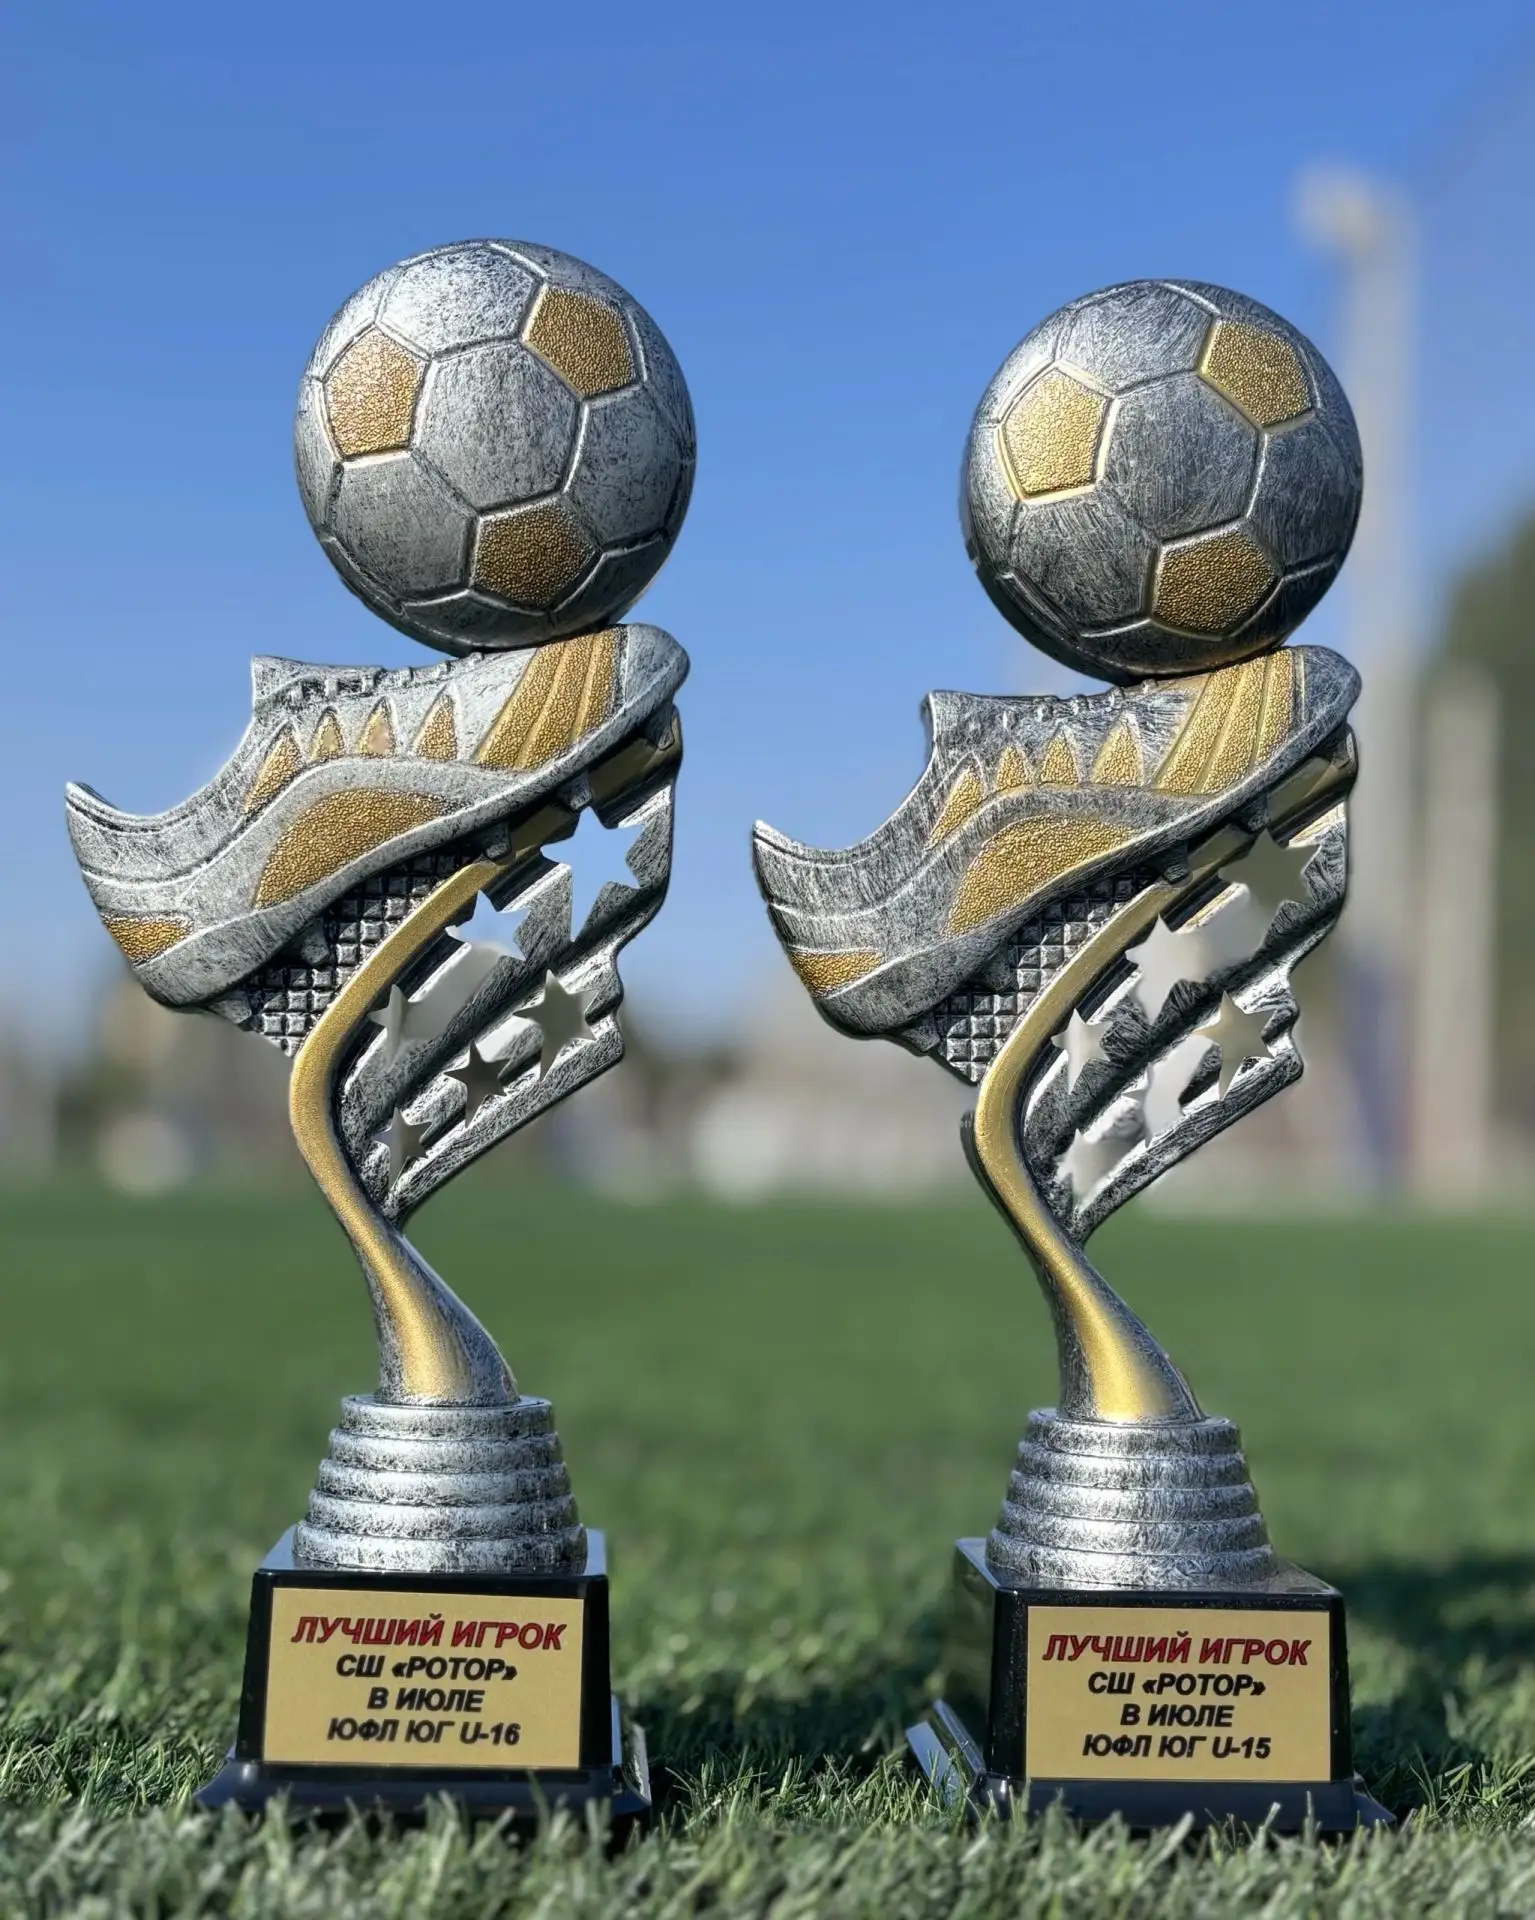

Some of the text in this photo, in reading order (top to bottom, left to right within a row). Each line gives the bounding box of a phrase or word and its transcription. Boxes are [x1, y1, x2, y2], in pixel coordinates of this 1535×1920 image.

[291, 1613, 565, 1649] ЛУЧШИЙ ИГРОК
[1042, 1630, 1312, 1665] ЛУЧШИЙ ИГРОК
[336, 1654, 516, 1680] СШ «РОТОР»
[1088, 1671, 1266, 1696] СШ «РОТОР»
[367, 1687, 484, 1712] В ИЮЛЕ
[1120, 1703, 1235, 1728] В ИЮЛЕ
[327, 1718, 519, 1744] ЮФЛ ЮГ U-16
[1082, 1734, 1271, 1760] ЮФЛ ЮГ U-15
